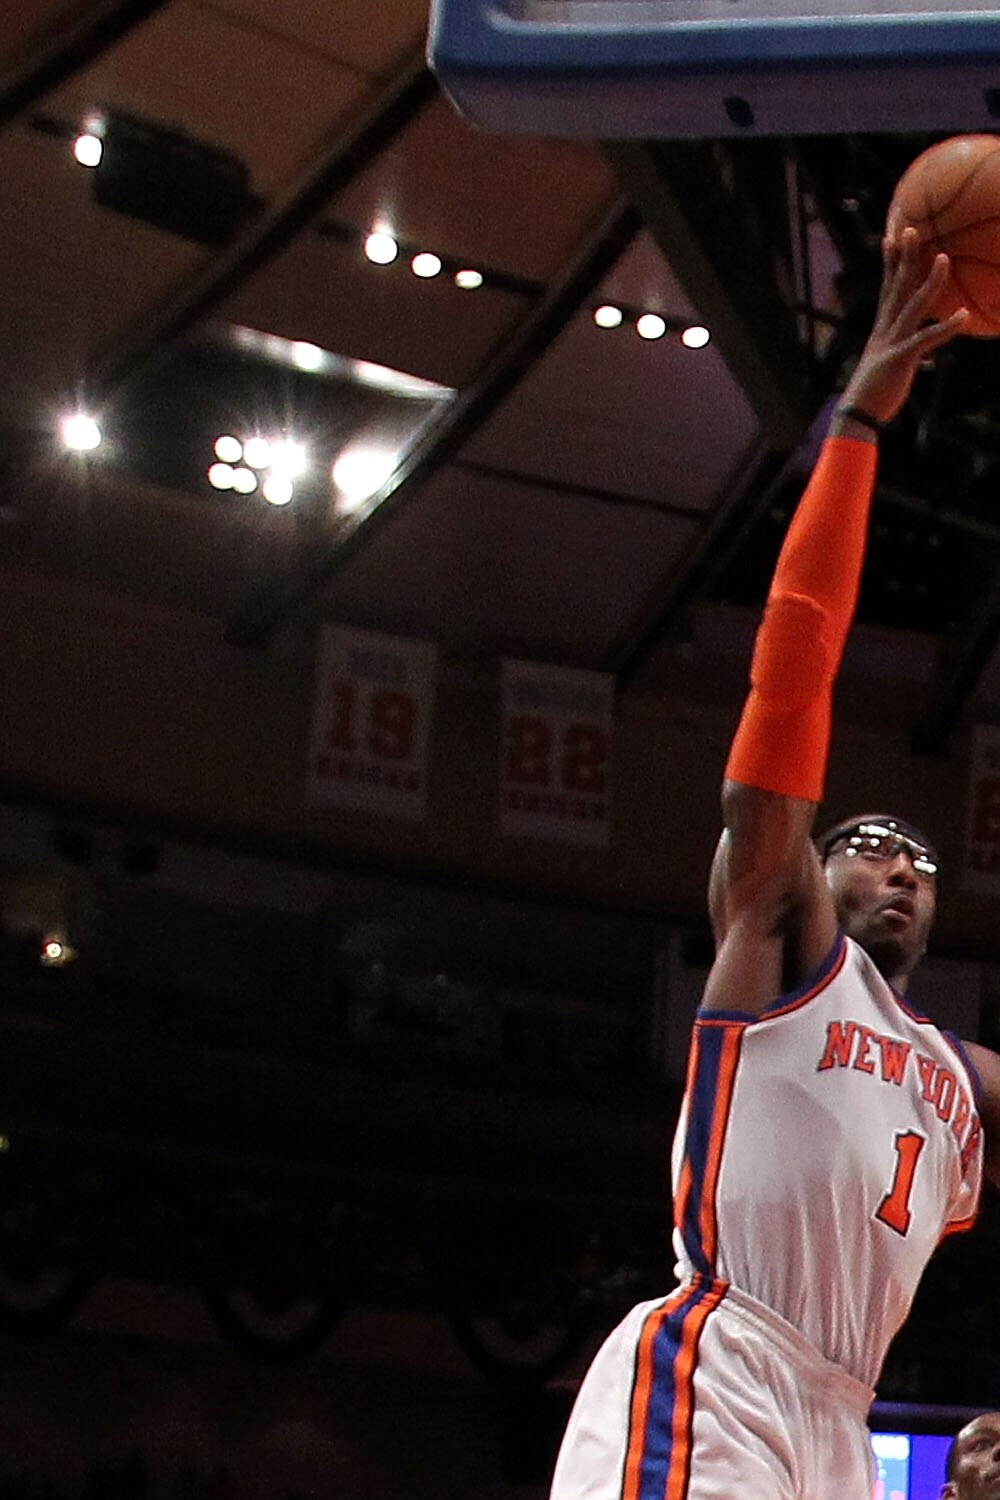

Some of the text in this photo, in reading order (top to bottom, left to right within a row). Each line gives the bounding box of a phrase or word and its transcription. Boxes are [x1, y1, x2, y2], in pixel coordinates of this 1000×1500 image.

[331, 684, 414, 758] 19
[508, 716, 609, 791] 22
[817, 1021, 912, 1087] NEW
[875, 1131, 927, 1238] 1
